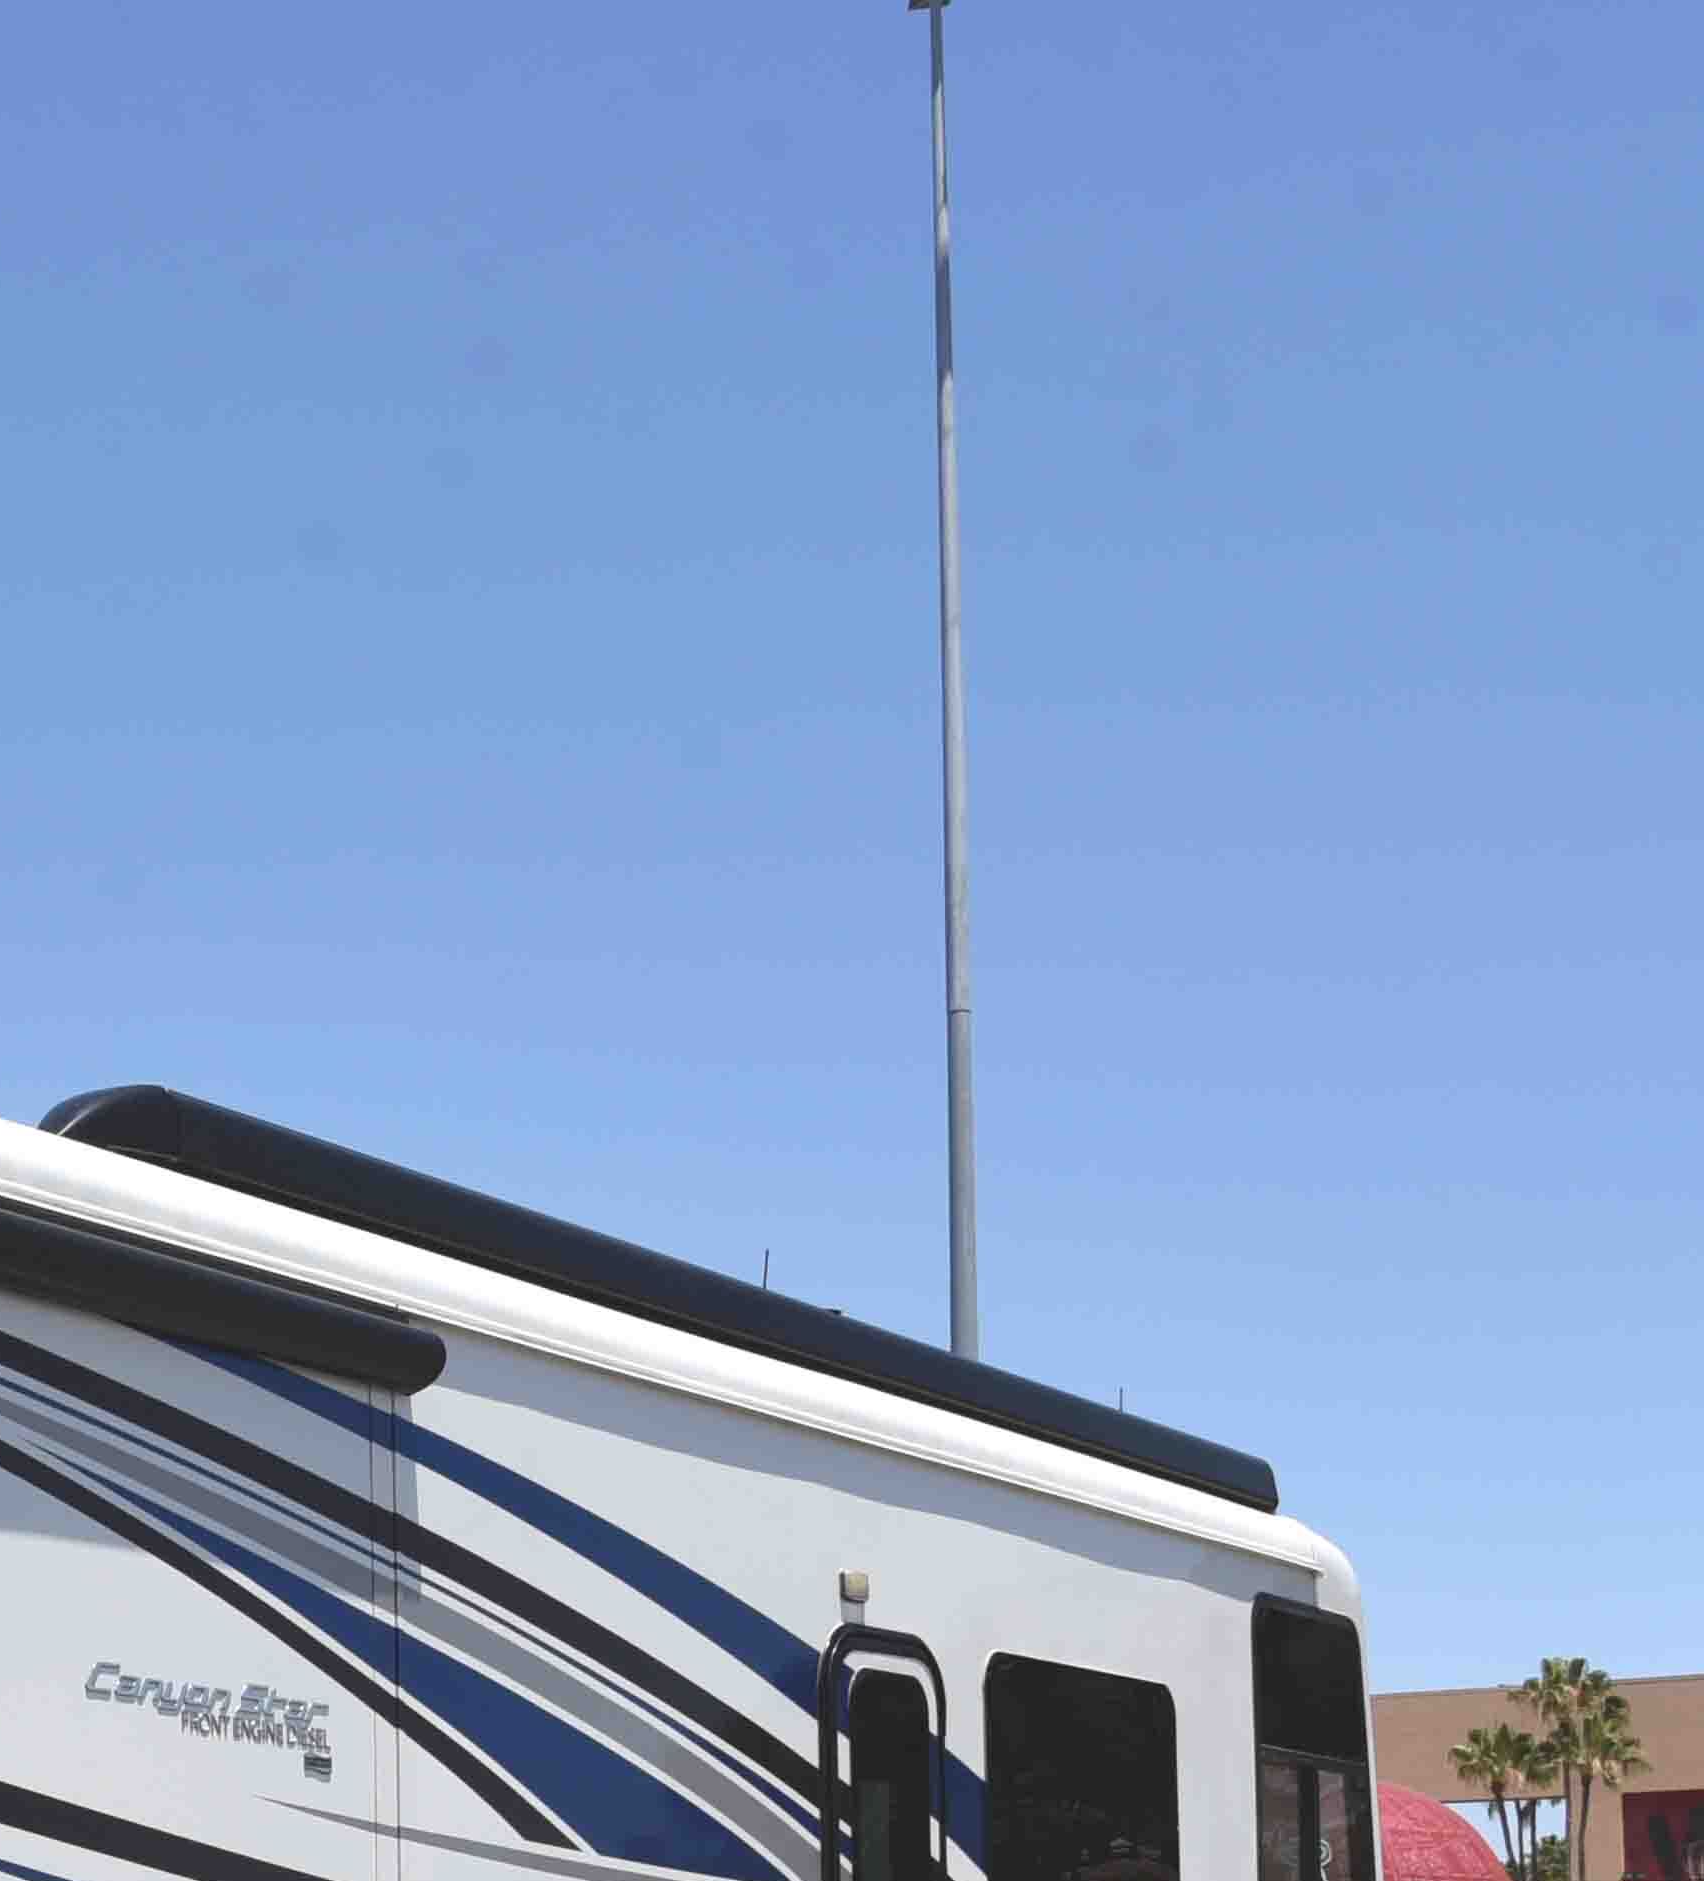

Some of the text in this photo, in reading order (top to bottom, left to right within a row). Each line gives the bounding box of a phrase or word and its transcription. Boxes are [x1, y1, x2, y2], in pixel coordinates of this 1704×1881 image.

[85, 1661, 330, 1727] Canyon Star
[180, 1711, 331, 1753] FRONT ENGINE DIESEL
